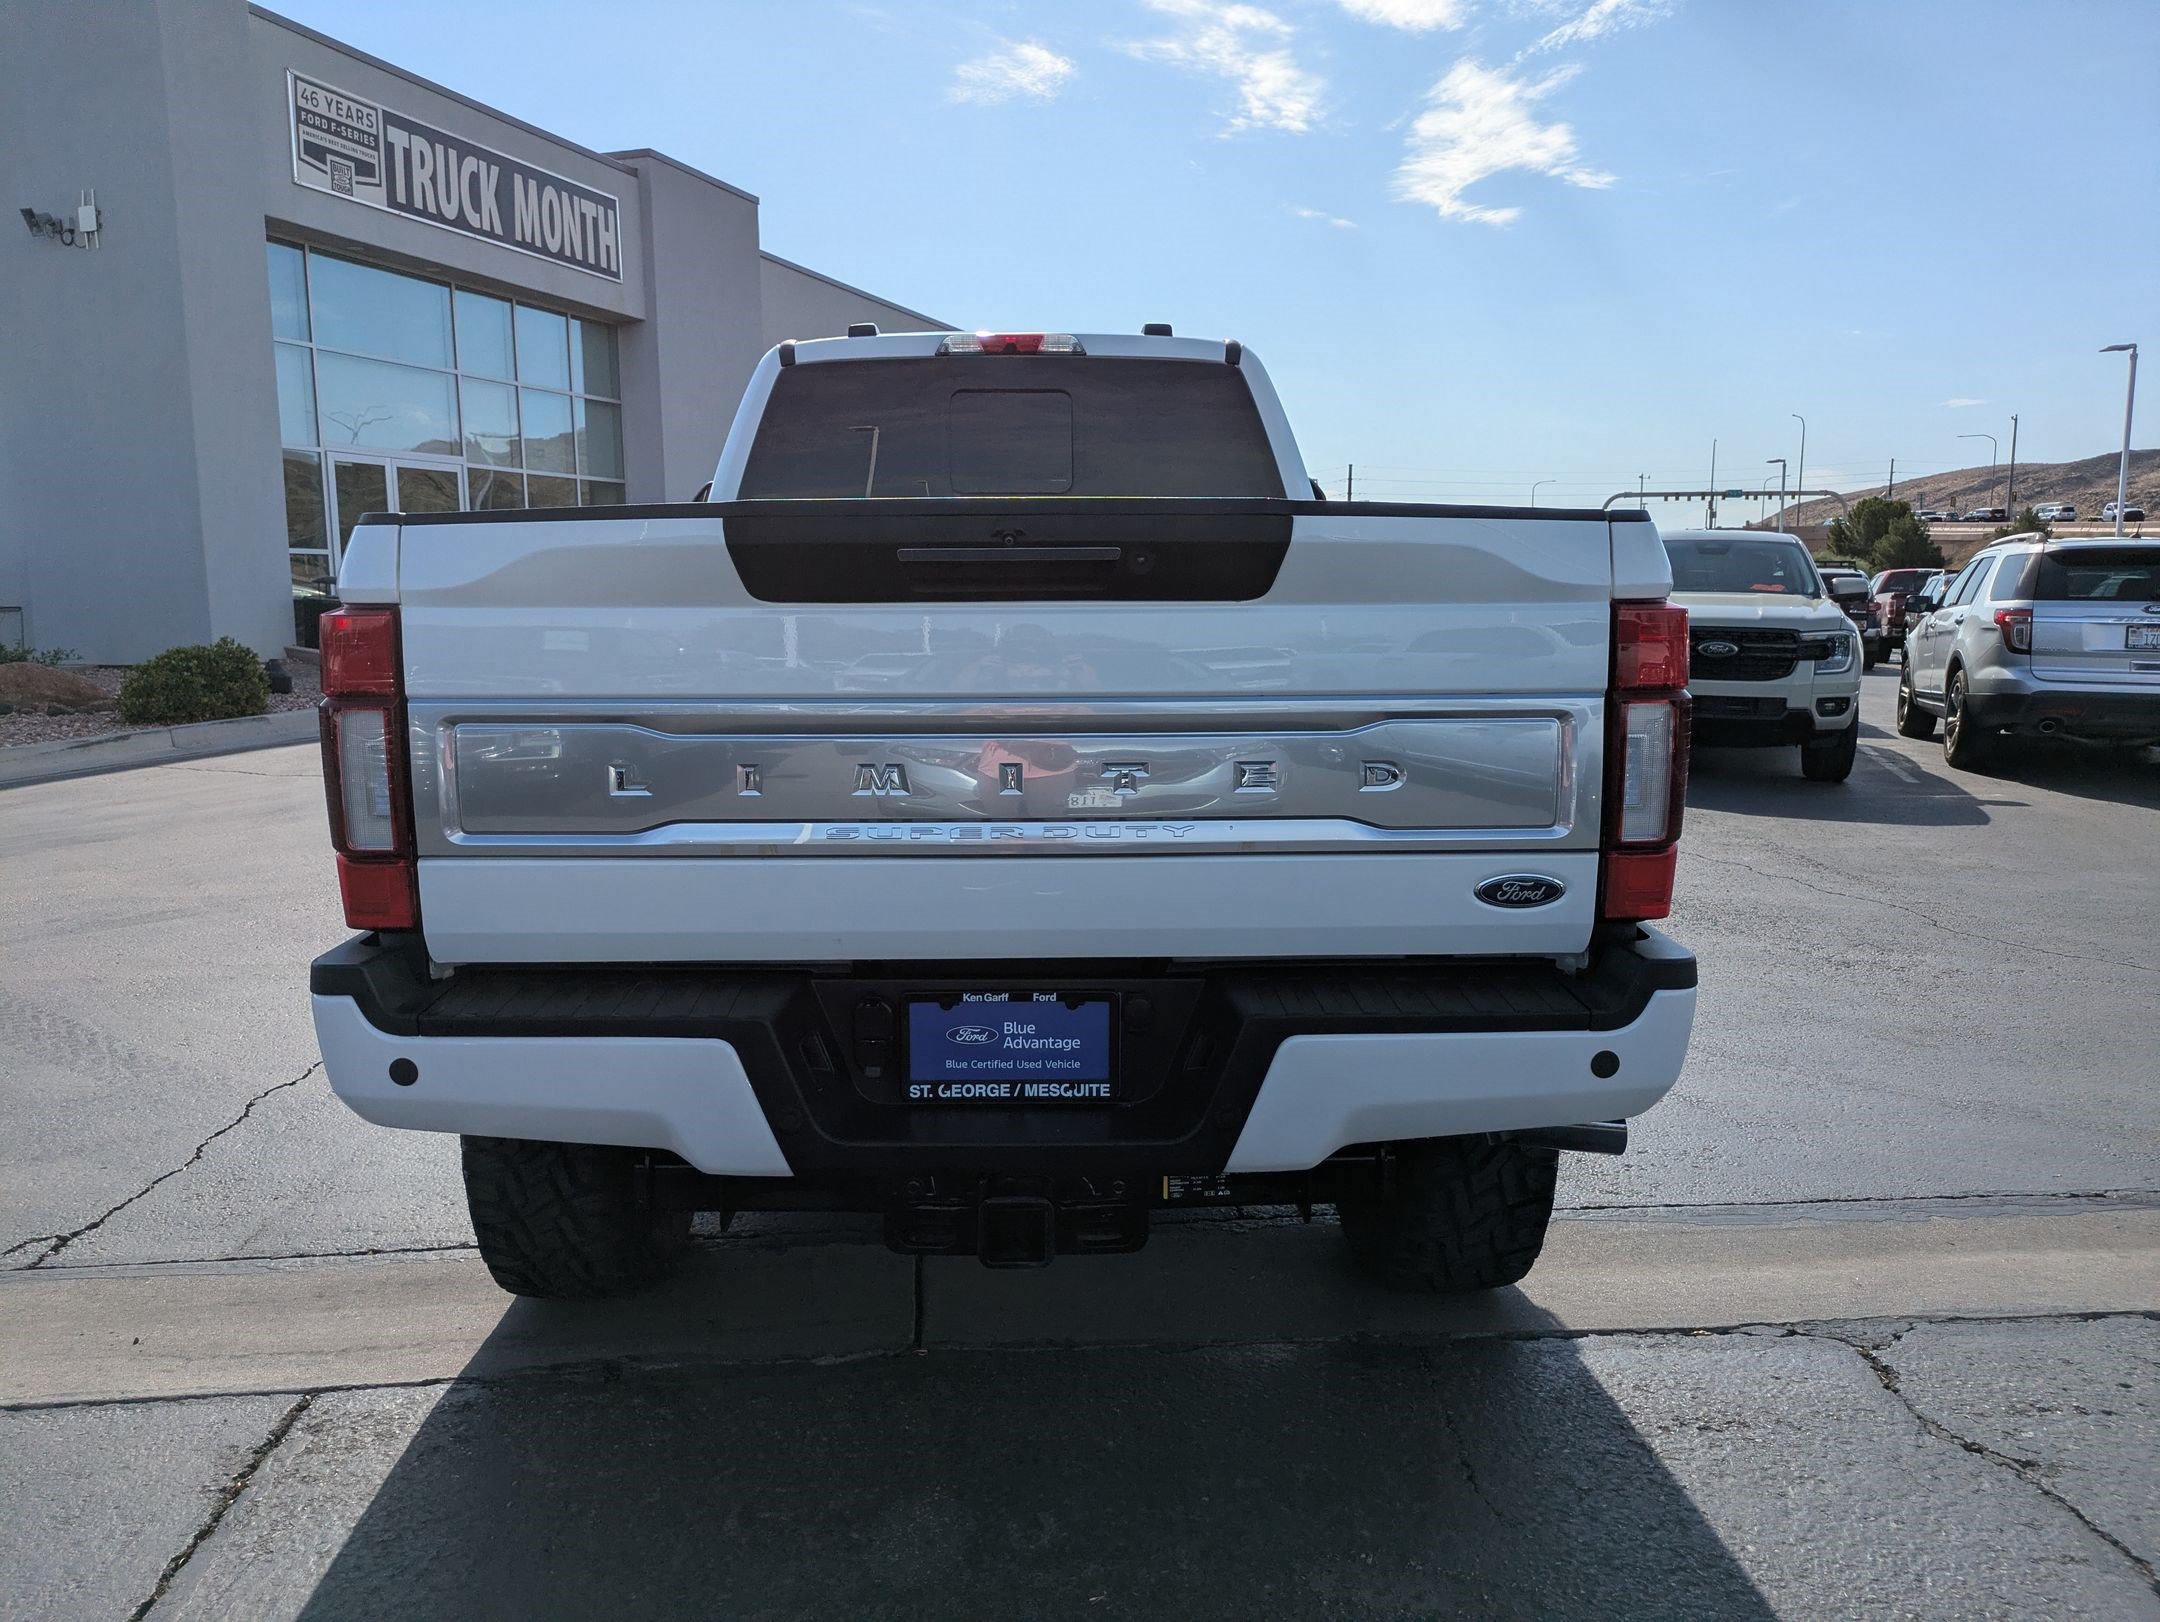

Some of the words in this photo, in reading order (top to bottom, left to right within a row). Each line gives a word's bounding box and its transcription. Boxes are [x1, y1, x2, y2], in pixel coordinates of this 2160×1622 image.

[301, 87, 319, 108] 46
[324, 95, 374, 128] YEARS
[301, 111, 328, 129] FORD
[331, 123, 376, 147] F-SERIES
[332, 163, 351, 177] BUILT
[387, 124, 503, 236] TRUCK
[513, 172, 618, 272] MONTH
[608, 760, 1408, 797] LIMITED
[826, 824, 1025, 841] SUPER
[1042, 824, 1196, 839] DUTY
[963, 993, 982, 1002] Ken
[984, 992, 1009, 1002] Garff
[1033, 992, 1056, 1002] Ford
[1003, 1022, 1036, 1034] Blue
[1003, 1037, 1081, 1051] Advantage
[946, 1060, 968, 1069] Blue
[971, 1059, 1013, 1069] Certified
[1016, 1060, 1042, 1069] Used
[1045, 1060, 1081, 1069] Vehicle
[909, 1084, 933, 1098] ST.
[938, 1083, 1010, 1097] GEORGE
[1025, 1083, 1111, 1098] MESQUITE
